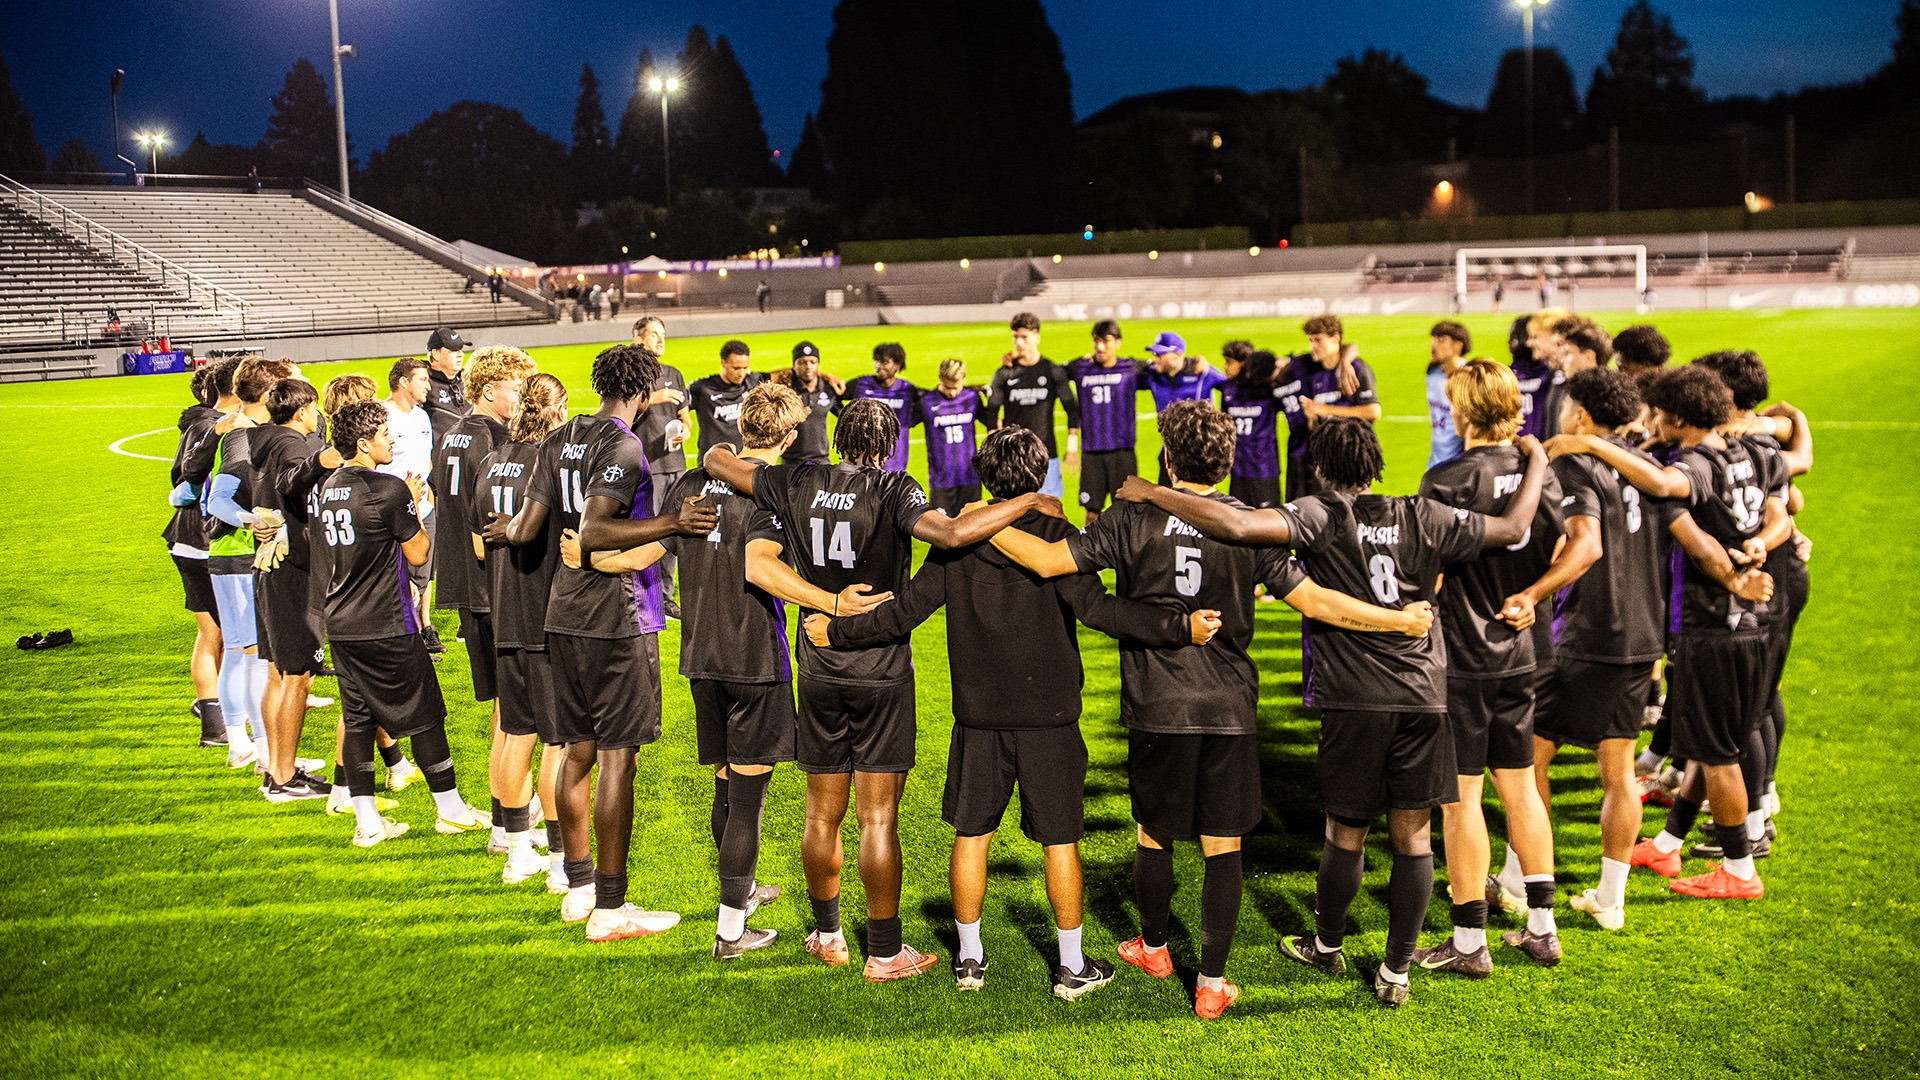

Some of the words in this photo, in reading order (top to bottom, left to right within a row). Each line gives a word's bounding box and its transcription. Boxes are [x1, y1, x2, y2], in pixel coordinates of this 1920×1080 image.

[1091, 385, 1111, 404] 31
[442, 434, 473, 450] PILOTS
[944, 425, 965, 444] 15
[447, 456, 460, 496] 7
[487, 462, 525, 479] PILOTS
[322, 486, 352, 504] PILOTS
[491, 485, 515, 516] 11
[810, 489, 857, 511] PILOTS
[321, 508, 356, 547] 33
[809, 517, 857, 569] 14
[1175, 545, 1203, 597] 5
[1369, 553, 1400, 604] 8
